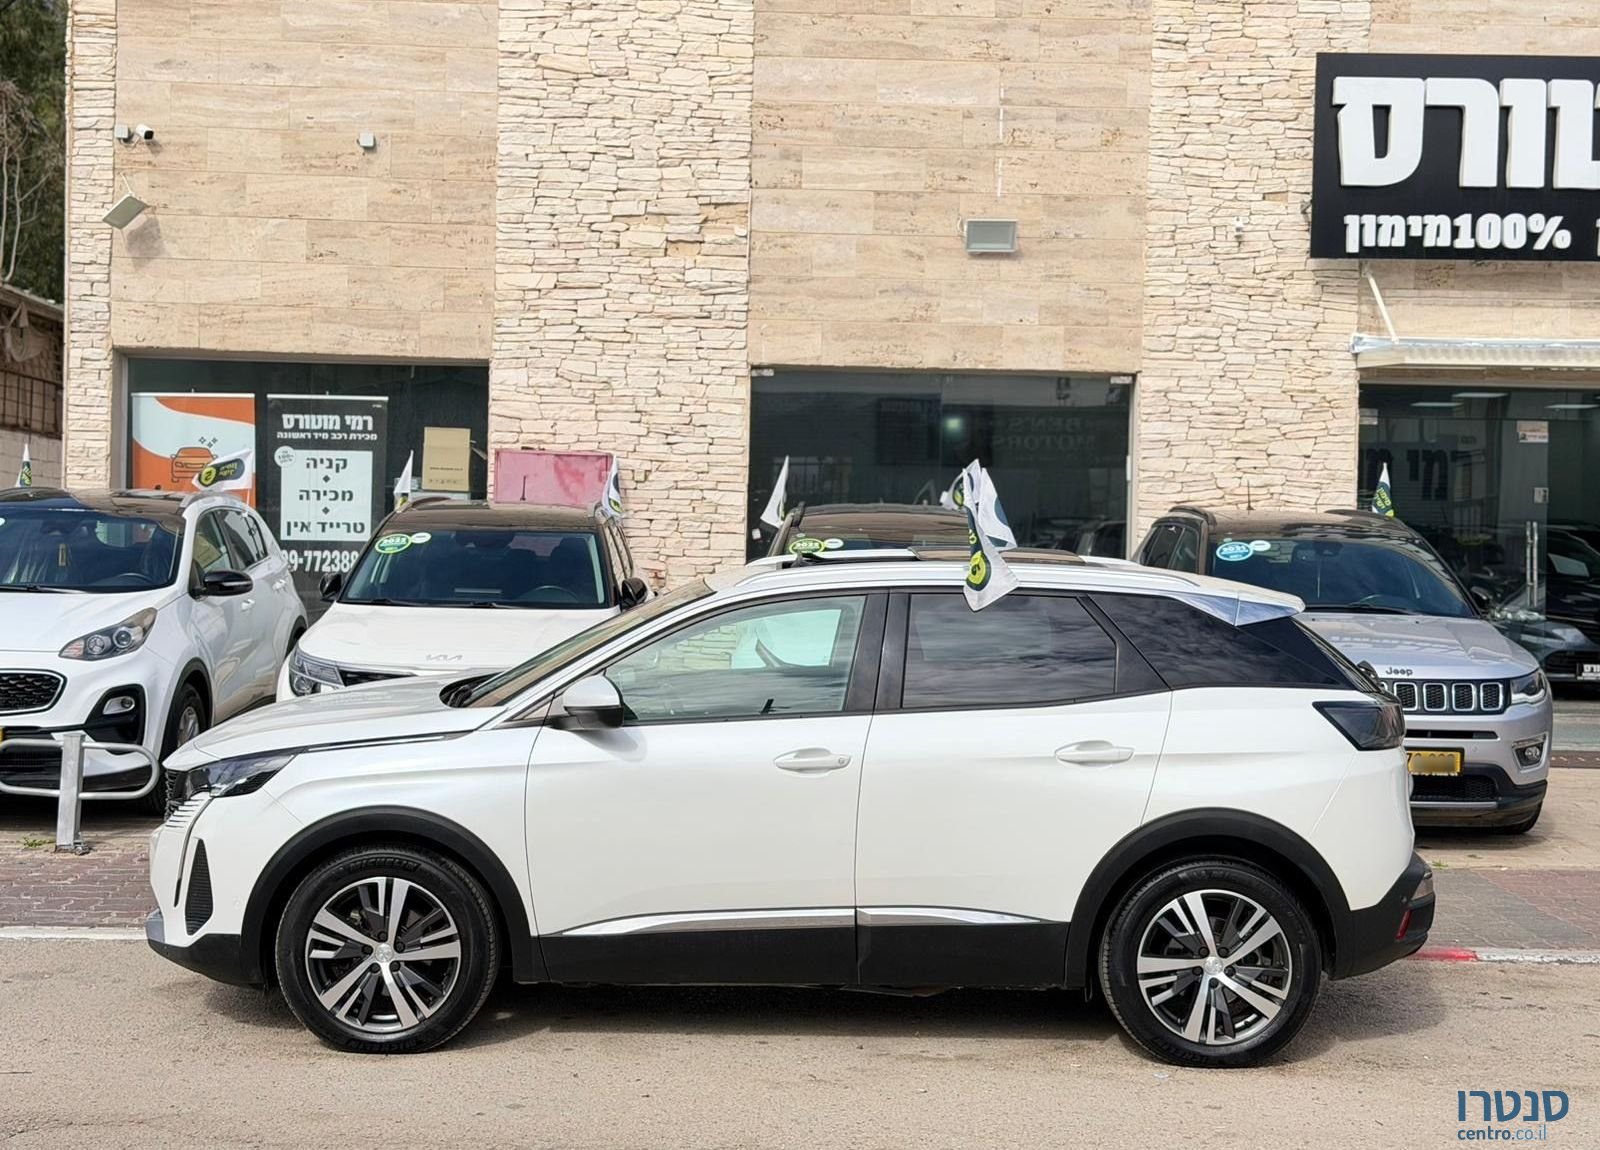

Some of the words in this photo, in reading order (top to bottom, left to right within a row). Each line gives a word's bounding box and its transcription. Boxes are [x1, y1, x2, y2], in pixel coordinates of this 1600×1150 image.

[282, 413, 340, 430] מוטורס
[344, 415, 373, 431] רמי
[276, 431, 311, 439] ראשונה
[331, 432, 347, 440] רכב
[349, 432, 378, 440] מכירת
[306, 457, 348, 473] קניה
[299, 489, 354, 501] מכירה
[286, 521, 311, 536] אין
[317, 521, 365, 533] טרייד
[1385, 666, 1414, 677] Jeep
